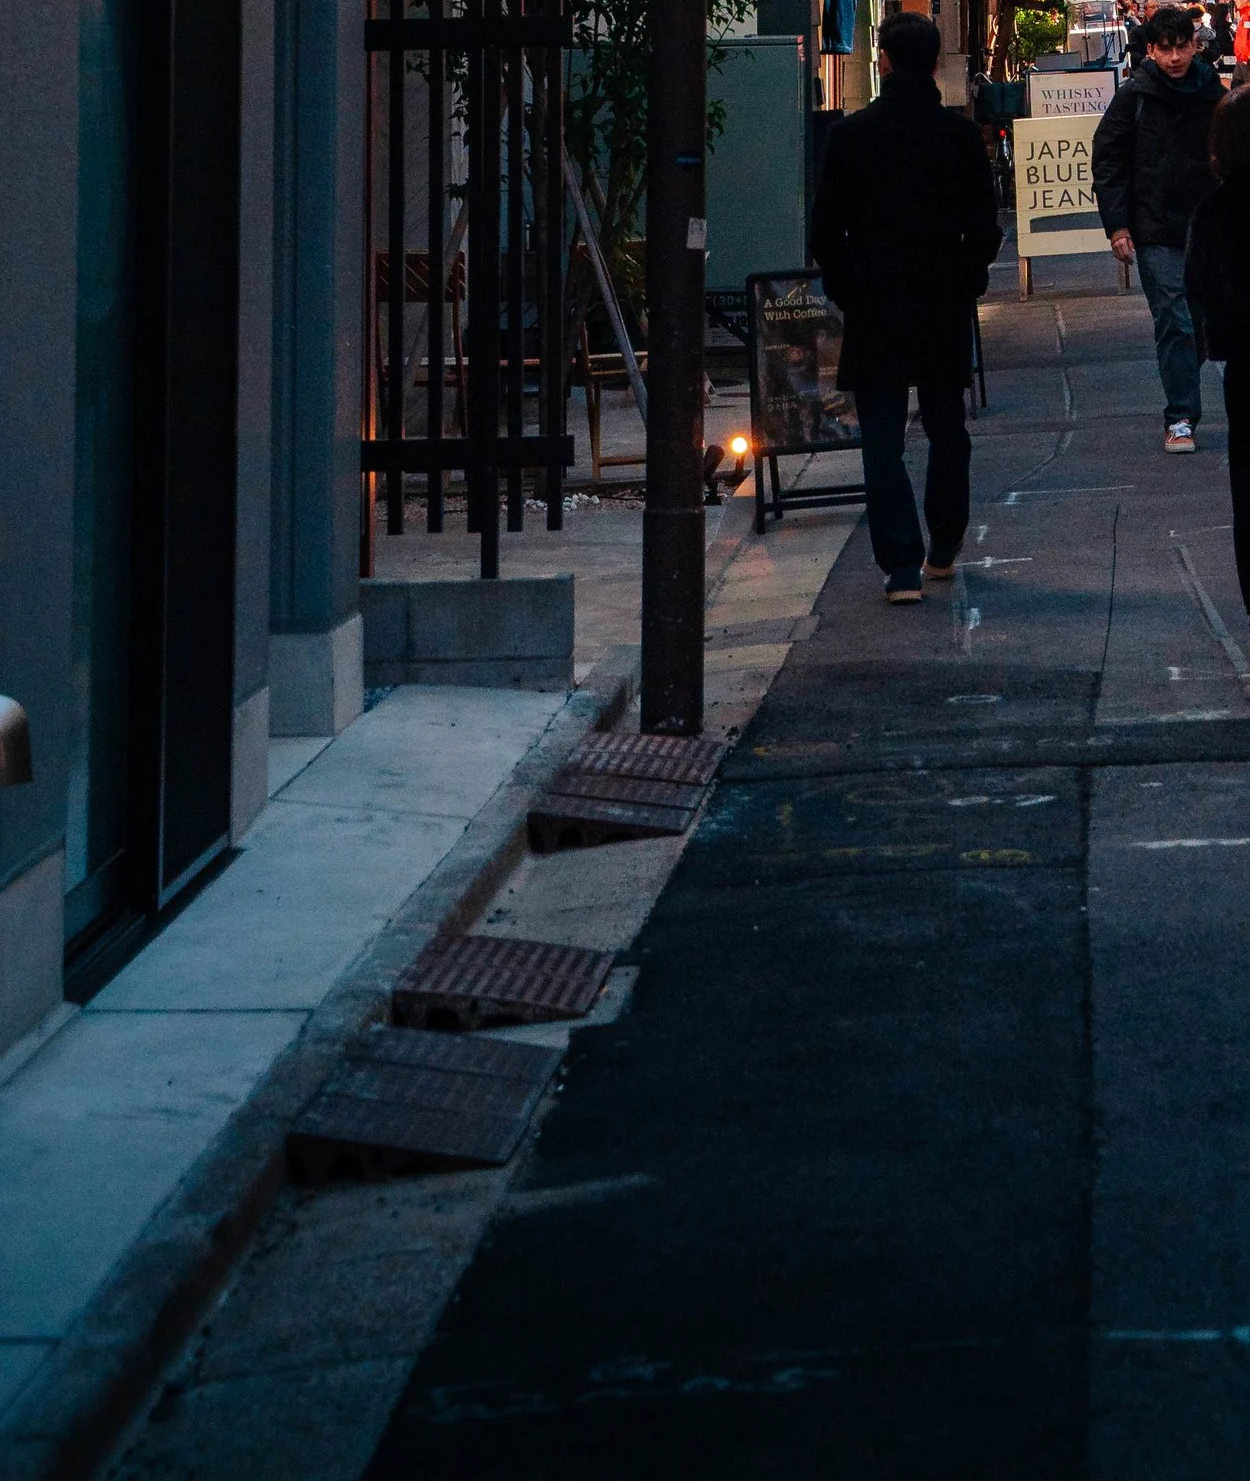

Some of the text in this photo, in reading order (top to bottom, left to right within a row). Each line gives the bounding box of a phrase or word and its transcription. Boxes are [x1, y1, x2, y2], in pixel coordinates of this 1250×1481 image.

[1042, 87, 1105, 100] WHISKY
[1042, 101, 1108, 114] TASTING
[1026, 139, 1093, 162] JAPA
[1026, 162, 1091, 185] BLUE
[764, 294, 827, 308] A Good Day
[764, 308, 827, 321] With Coffee
